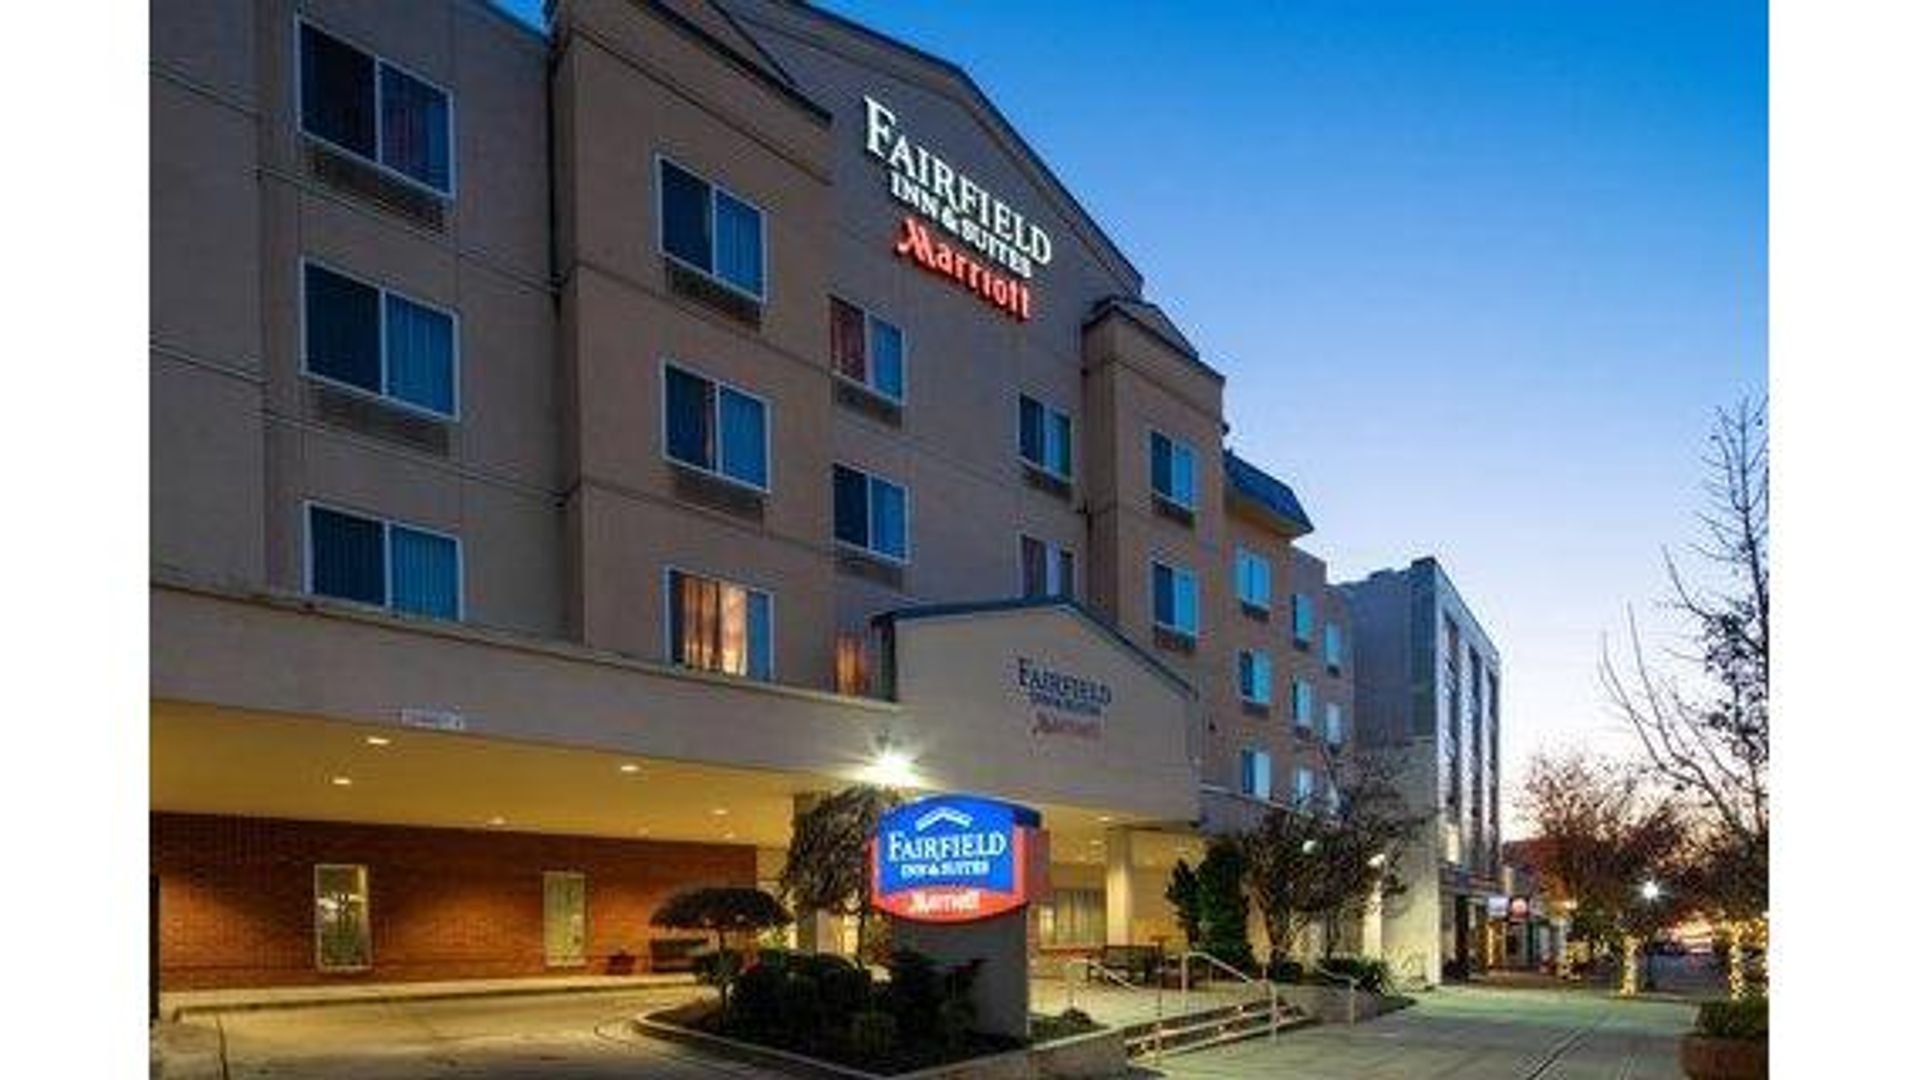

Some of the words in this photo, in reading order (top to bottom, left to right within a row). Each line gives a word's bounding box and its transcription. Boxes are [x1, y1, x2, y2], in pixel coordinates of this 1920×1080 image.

[864, 95, 1052, 266] FAIRFIELD
[890, 171, 939, 220] INN
[940, 206, 960, 234] &
[961, 217, 1032, 278] SUITES
[897, 217, 1031, 319] Marriott
[888, 831, 1007, 862] FAIRFIELD
